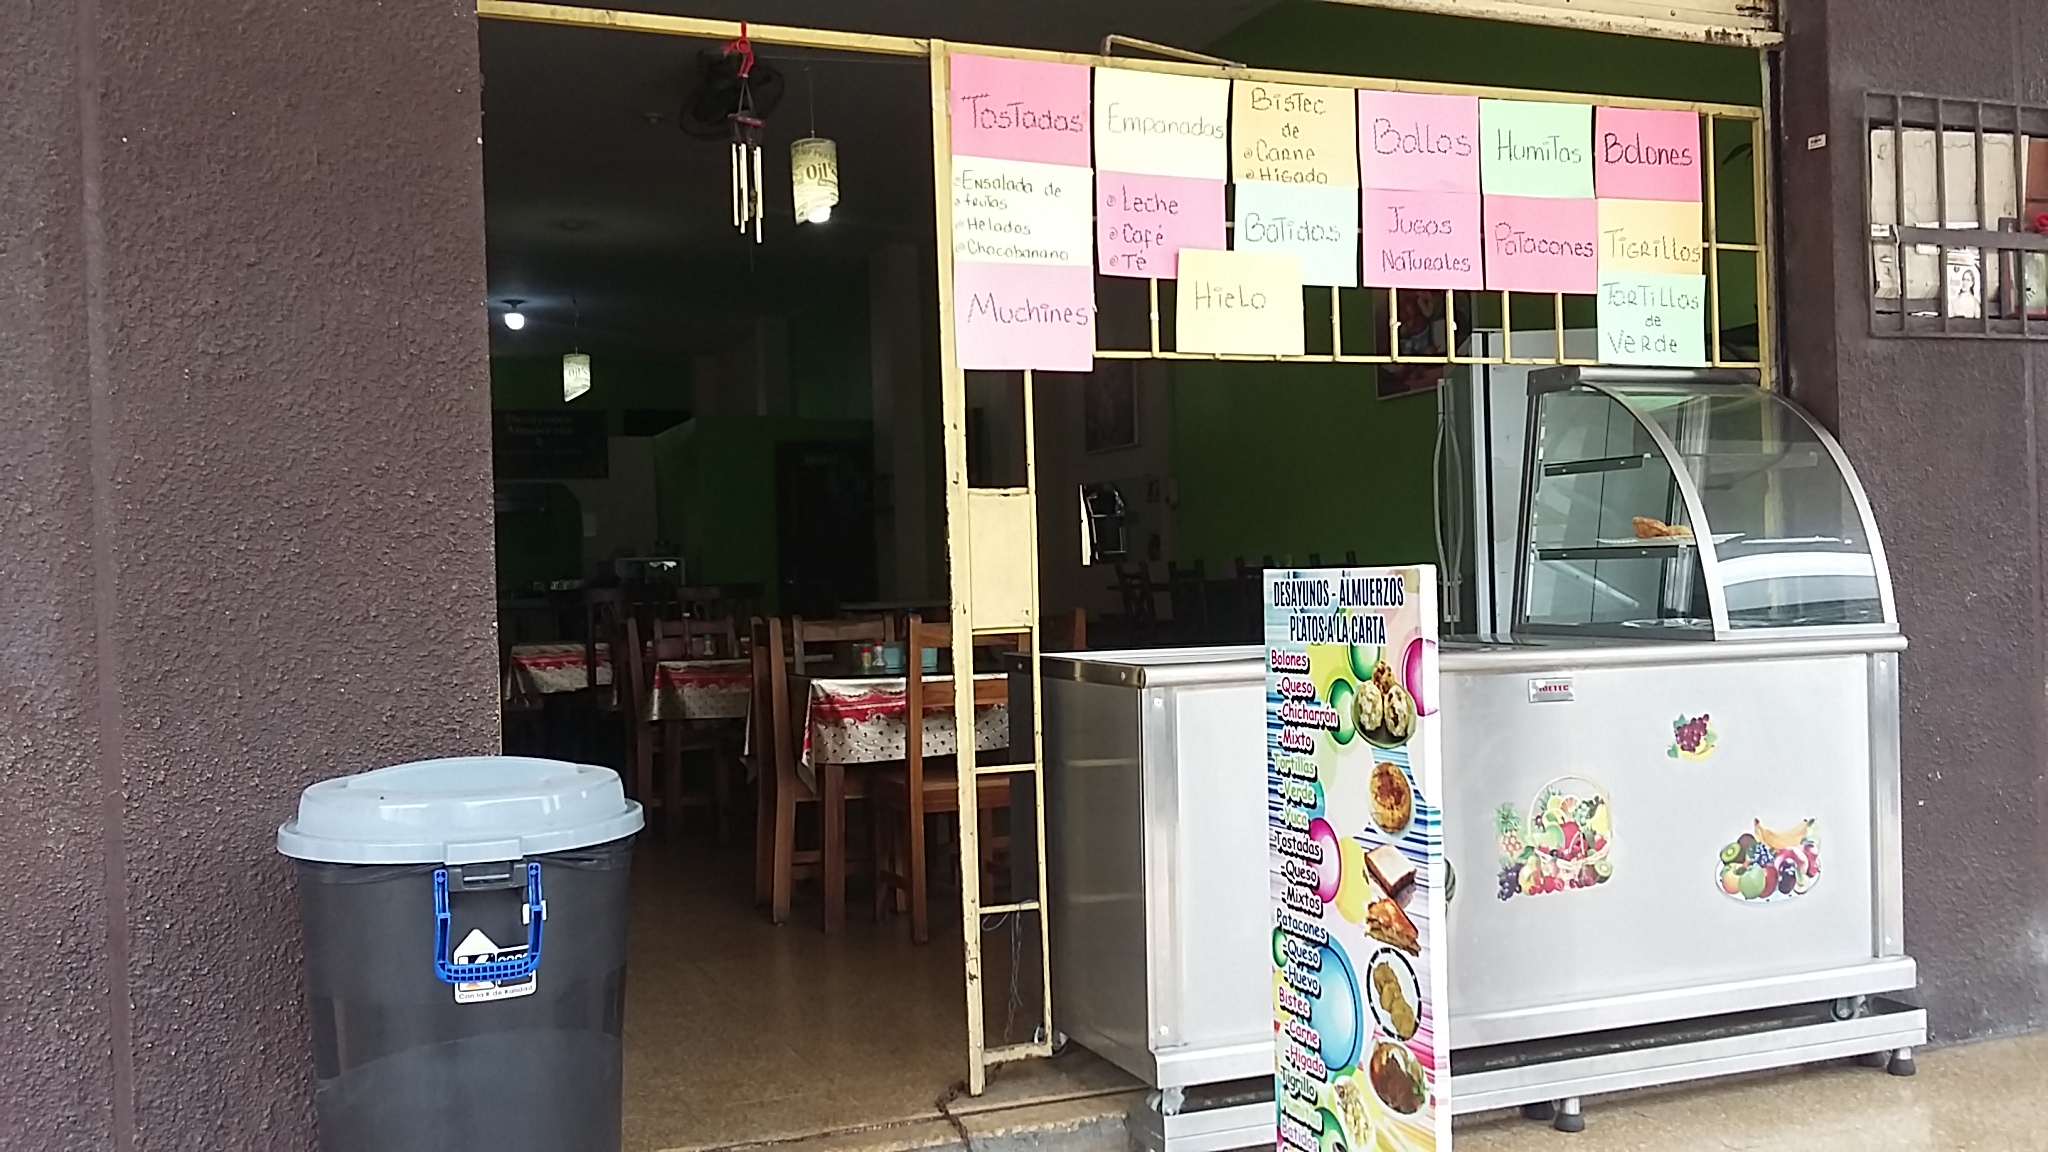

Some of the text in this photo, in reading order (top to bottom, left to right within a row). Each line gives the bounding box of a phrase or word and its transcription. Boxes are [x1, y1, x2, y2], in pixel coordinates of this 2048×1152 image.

[1108, 102, 1225, 139] Empanadas
[1281, 122, 1300, 139] de
[1603, 132, 1693, 166] Bolones
[1044, 183, 1062, 198] de
[1122, 184, 1180, 216] Leche
[966, 217, 1031, 236] Helados
[1121, 250, 1147, 271] Té
[966, 292, 1089, 326] Muchines
[1645, 314, 1662, 327] de
[1273, 579, 1330, 607] DESAYUNOS
[1339, 577, 1404, 607] ALMUERZOS
[1290, 615, 1386, 644] PLATOS A LA CARTA
[1271, 649, 1307, 667] Bolones
[1273, 753, 1315, 775] Tortillas
[1275, 830, 1320, 856] Tostadas
[1276, 907, 1326, 939] Patacones
[1279, 986, 1308, 1013] Bistec
[1280, 1065, 1315, 1097] Tigrillo
